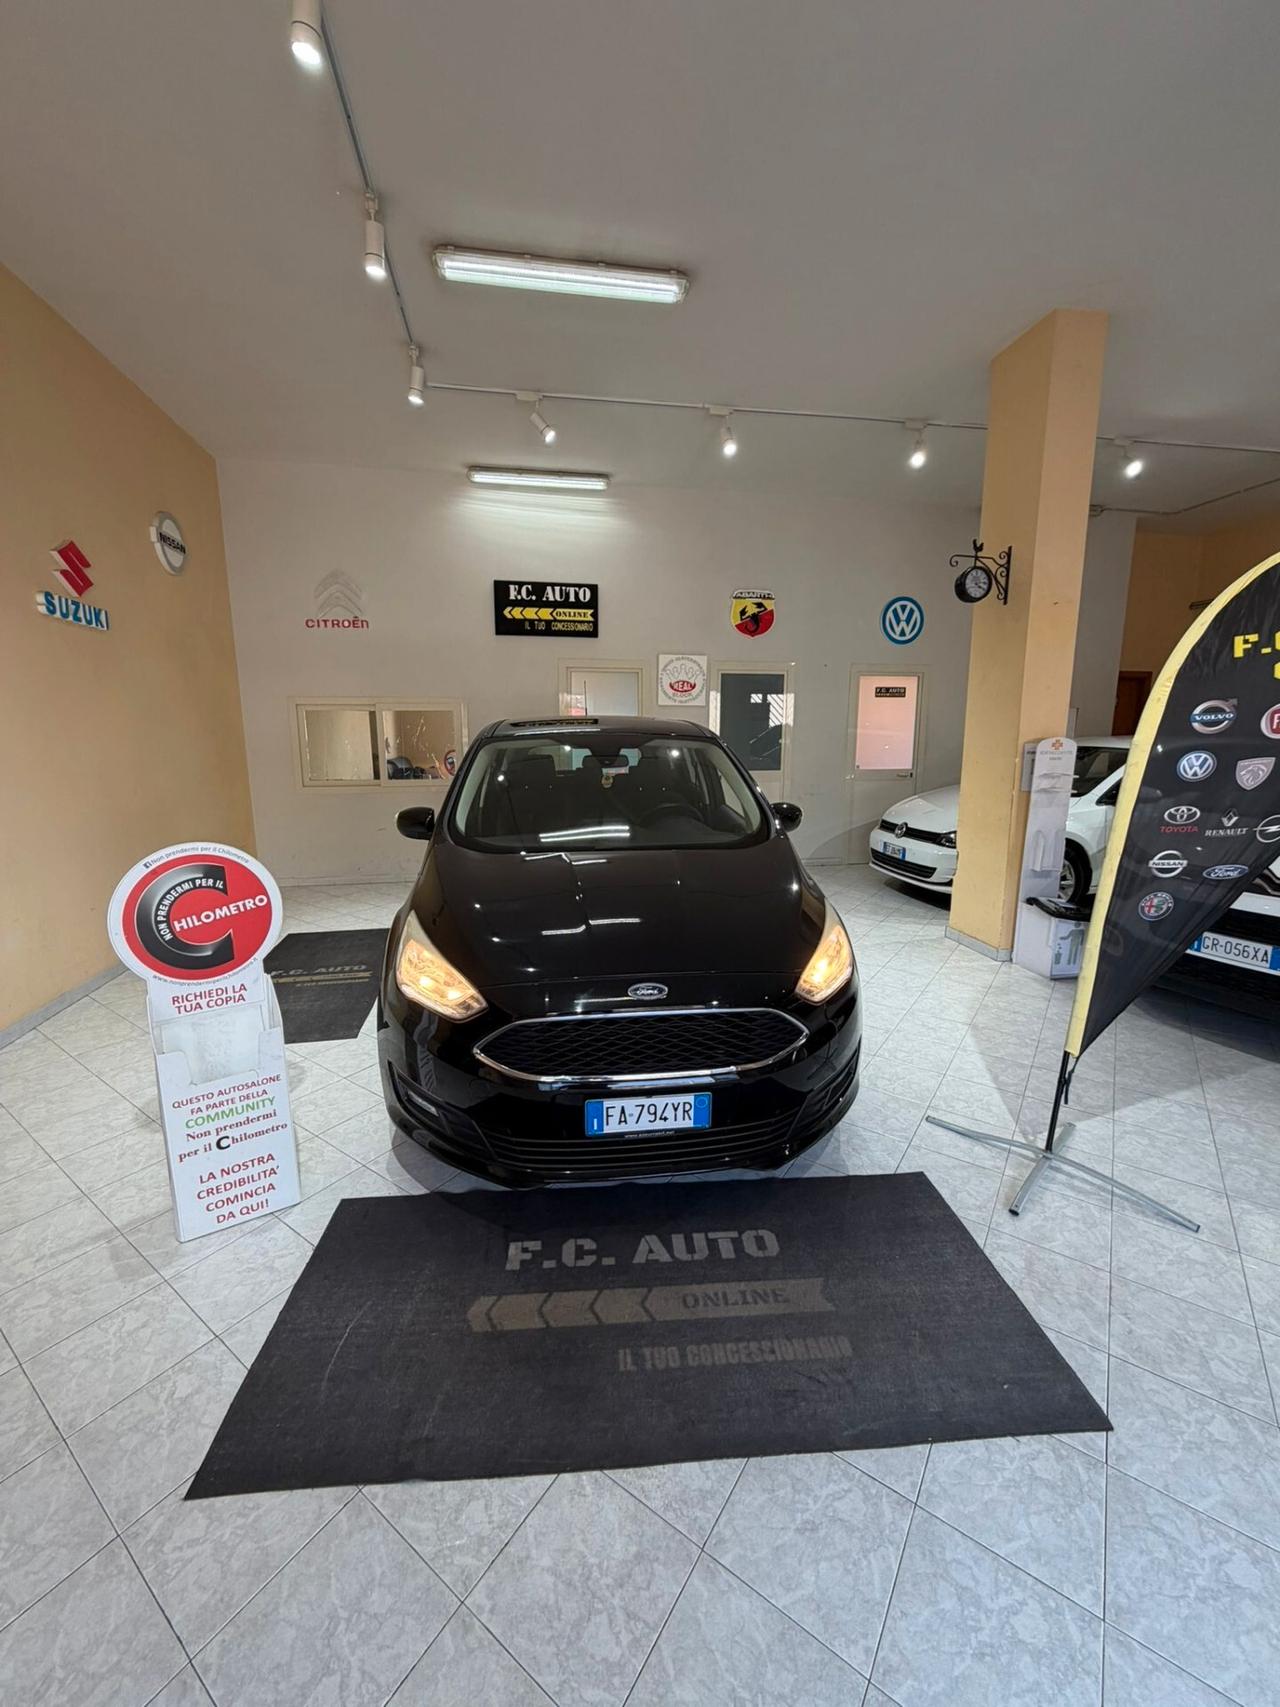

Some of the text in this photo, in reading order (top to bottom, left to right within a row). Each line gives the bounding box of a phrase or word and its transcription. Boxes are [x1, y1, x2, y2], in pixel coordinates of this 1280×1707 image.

[158, 532, 187, 555] NISSAN
[509, 584, 591, 602] F.C. AUTO
[43, 591, 110, 631] SUZUKI
[555, 610, 589, 618] ONLINE
[534, 621, 546, 630] TUO
[1194, 711, 1234, 721] VOLVO
[1160, 825, 1198, 833] TOYOTA
[1205, 828, 1248, 837] RENAULT
[1209, 867, 1240, 879] Ford
[157, 878, 224, 941] NON PRENDERMI PER IL
[172, 983, 247, 1006] RICHIEDI LA
[176, 993, 246, 1015] TUA COPIA
[172, 1074, 281, 1109] QUESTO AUTOSALONE
[190, 1089, 268, 1116] FA PARTE DELLA
[185, 1096, 276, 1129] COMMUNITY
[186, 1109, 277, 1142] Non prendermi
[178, 1122, 288, 1163] per il Chilometro
[199, 1153, 275, 1184] LA NOSTRA
[205, 1183, 276, 1212] COMINCIA
[216, 1198, 270, 1224] DA QUI!
[505, 1229, 781, 1271] F.C. AUTO
[681, 1287, 791, 1310] ONLINE
[617, 1348, 638, 1372] IL
[643, 1346, 681, 1371] TUO
